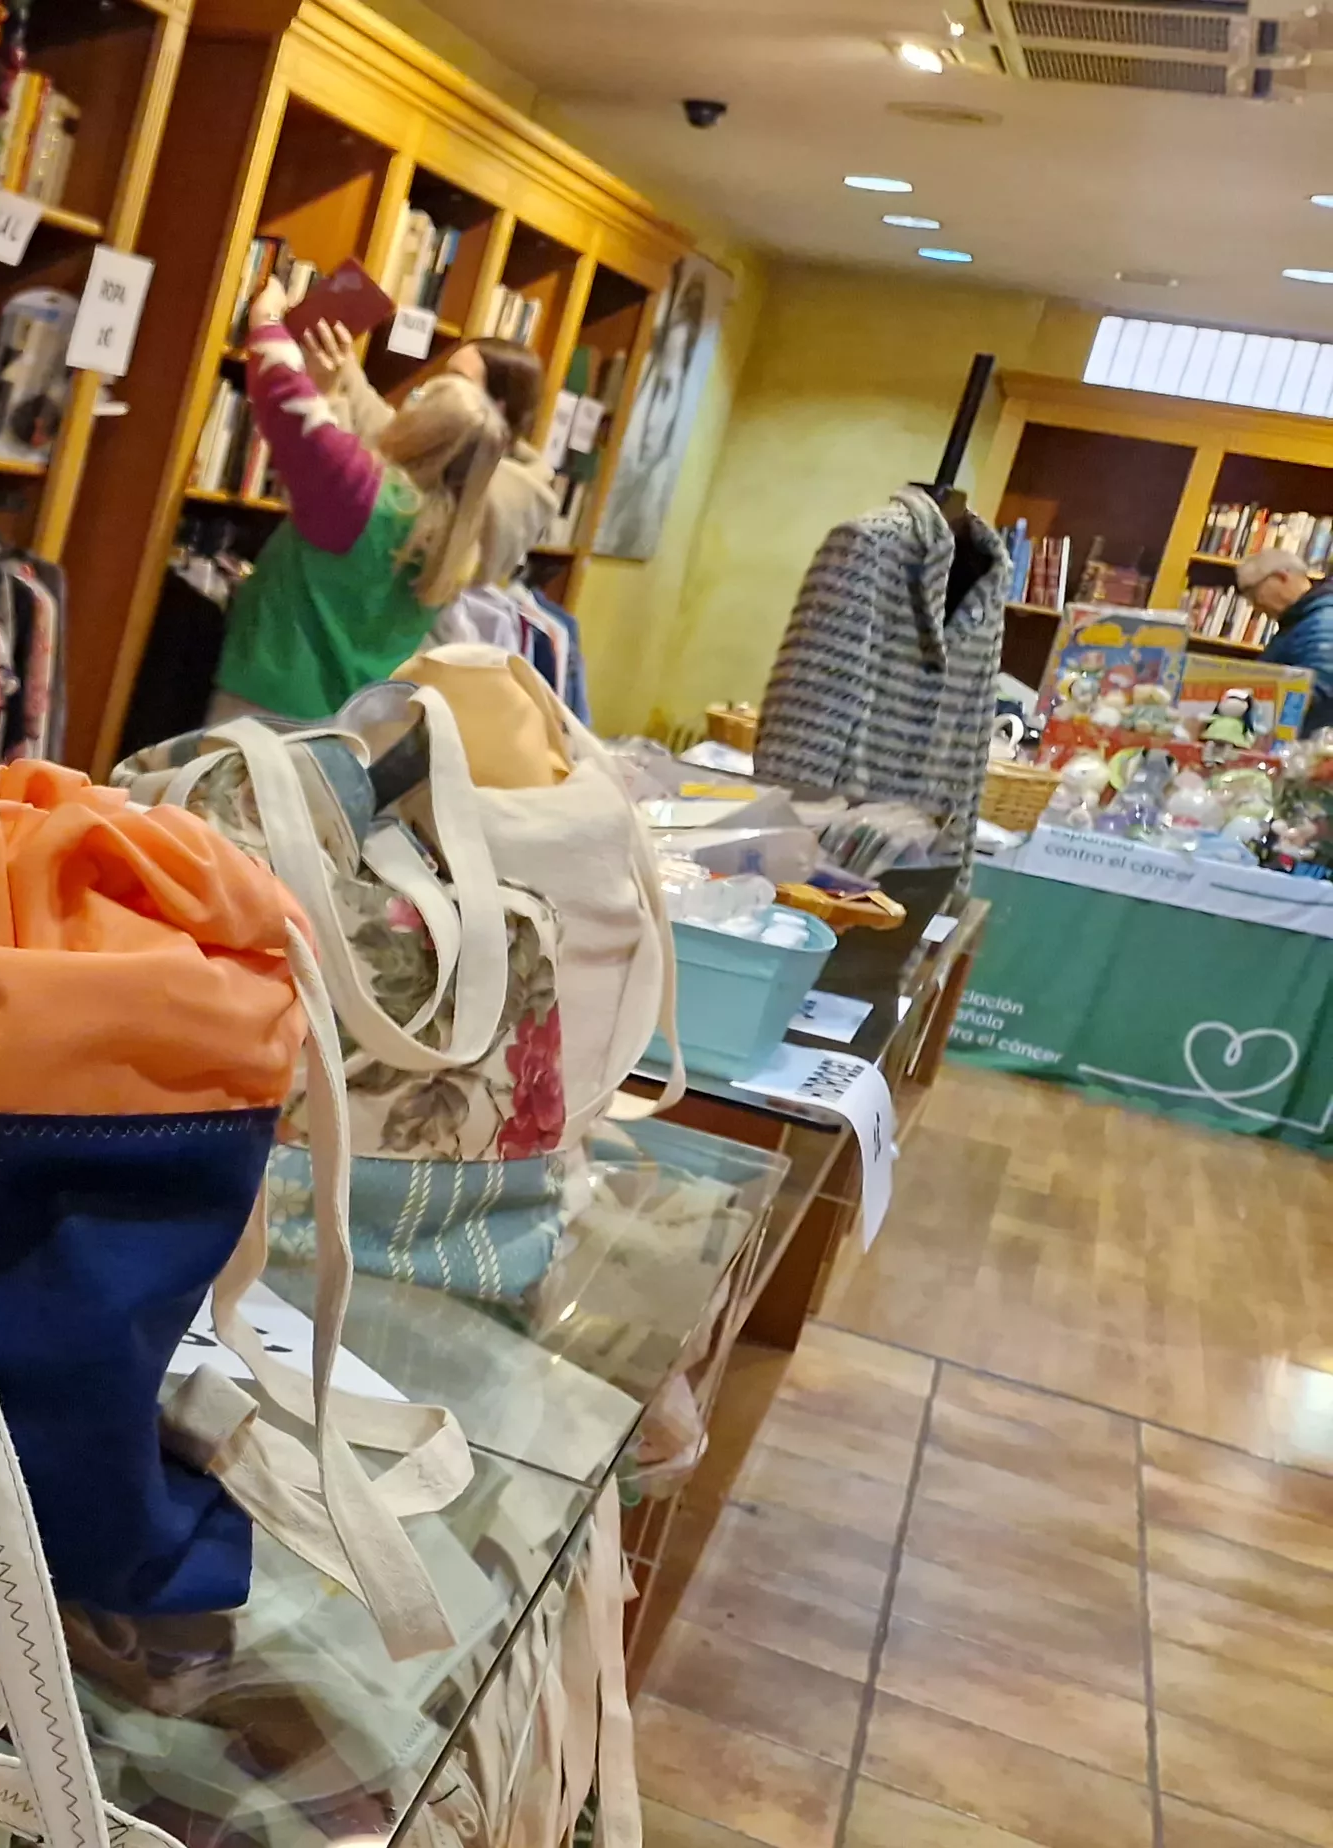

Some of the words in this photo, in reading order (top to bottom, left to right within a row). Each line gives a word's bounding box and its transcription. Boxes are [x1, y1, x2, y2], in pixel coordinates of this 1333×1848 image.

[1044, 843, 1104, 865] contra
[1109, 856, 1127, 869] el
[977, 1032, 996, 1047] el
[997, 1037, 1064, 1064] cáncer
